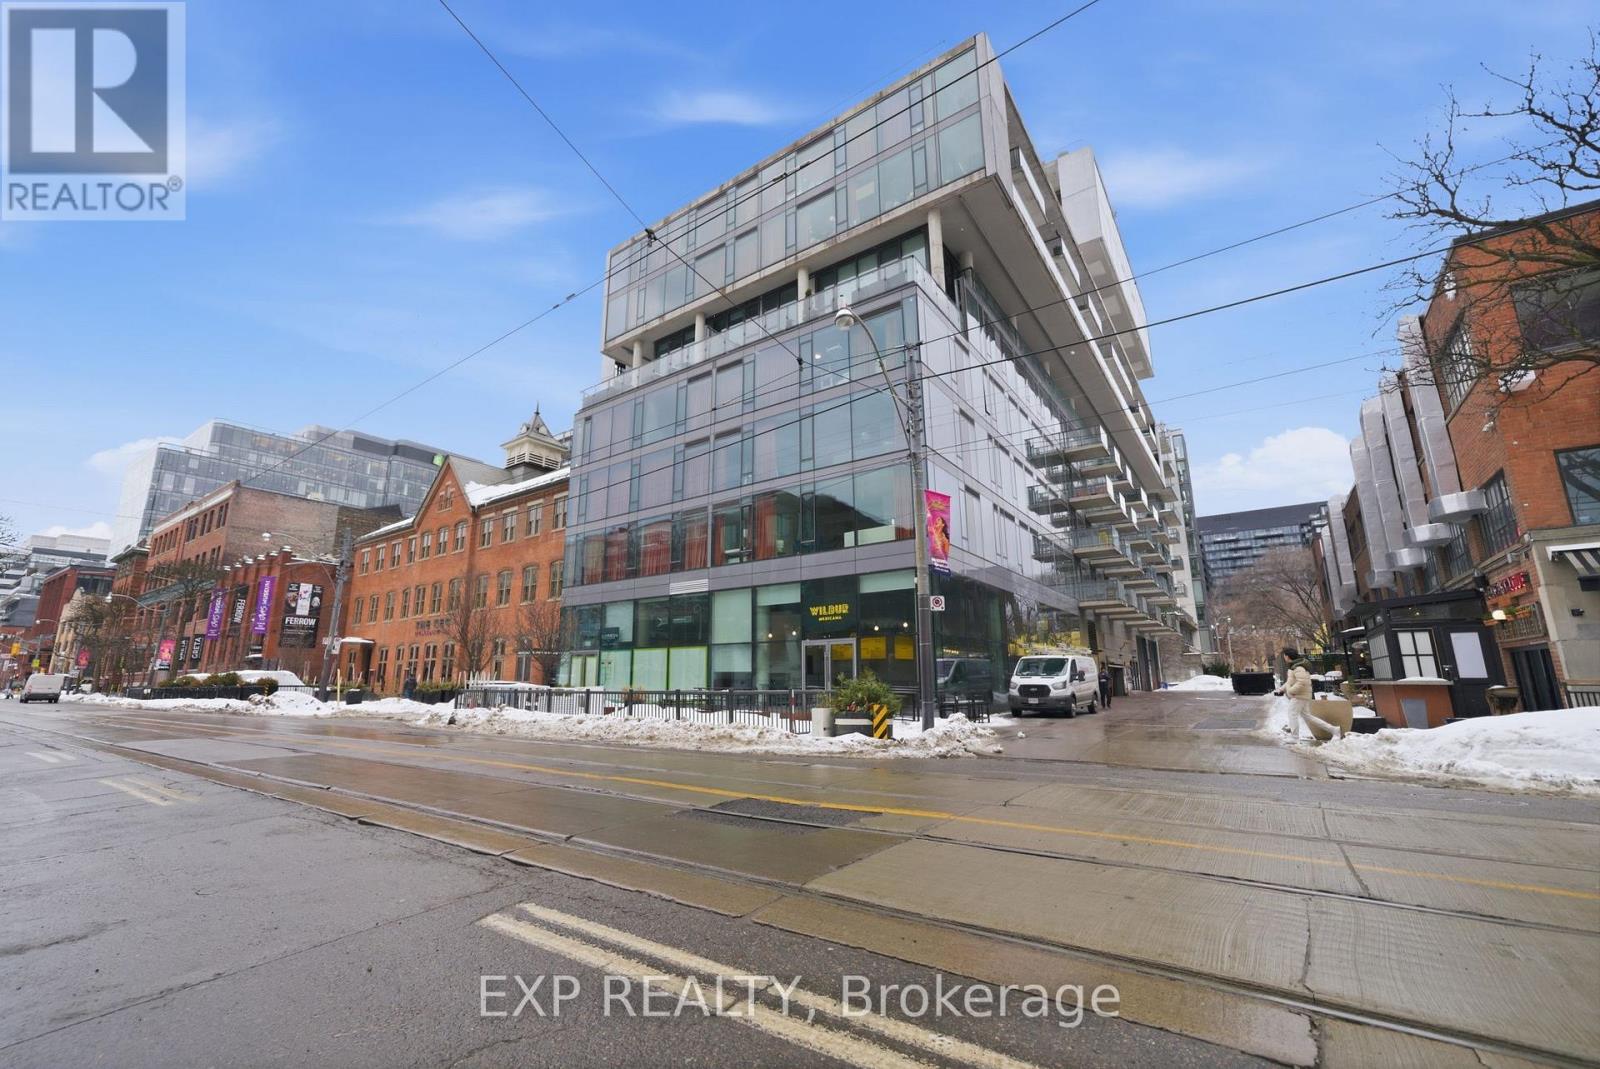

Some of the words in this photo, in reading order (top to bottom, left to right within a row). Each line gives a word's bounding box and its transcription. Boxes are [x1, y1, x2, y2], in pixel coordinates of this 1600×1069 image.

[234, 599, 246, 624] FERROW
[810, 604, 849, 616] WILBUR
[285, 616, 316, 626] FERROW
[191, 636, 203, 660] GRETA
